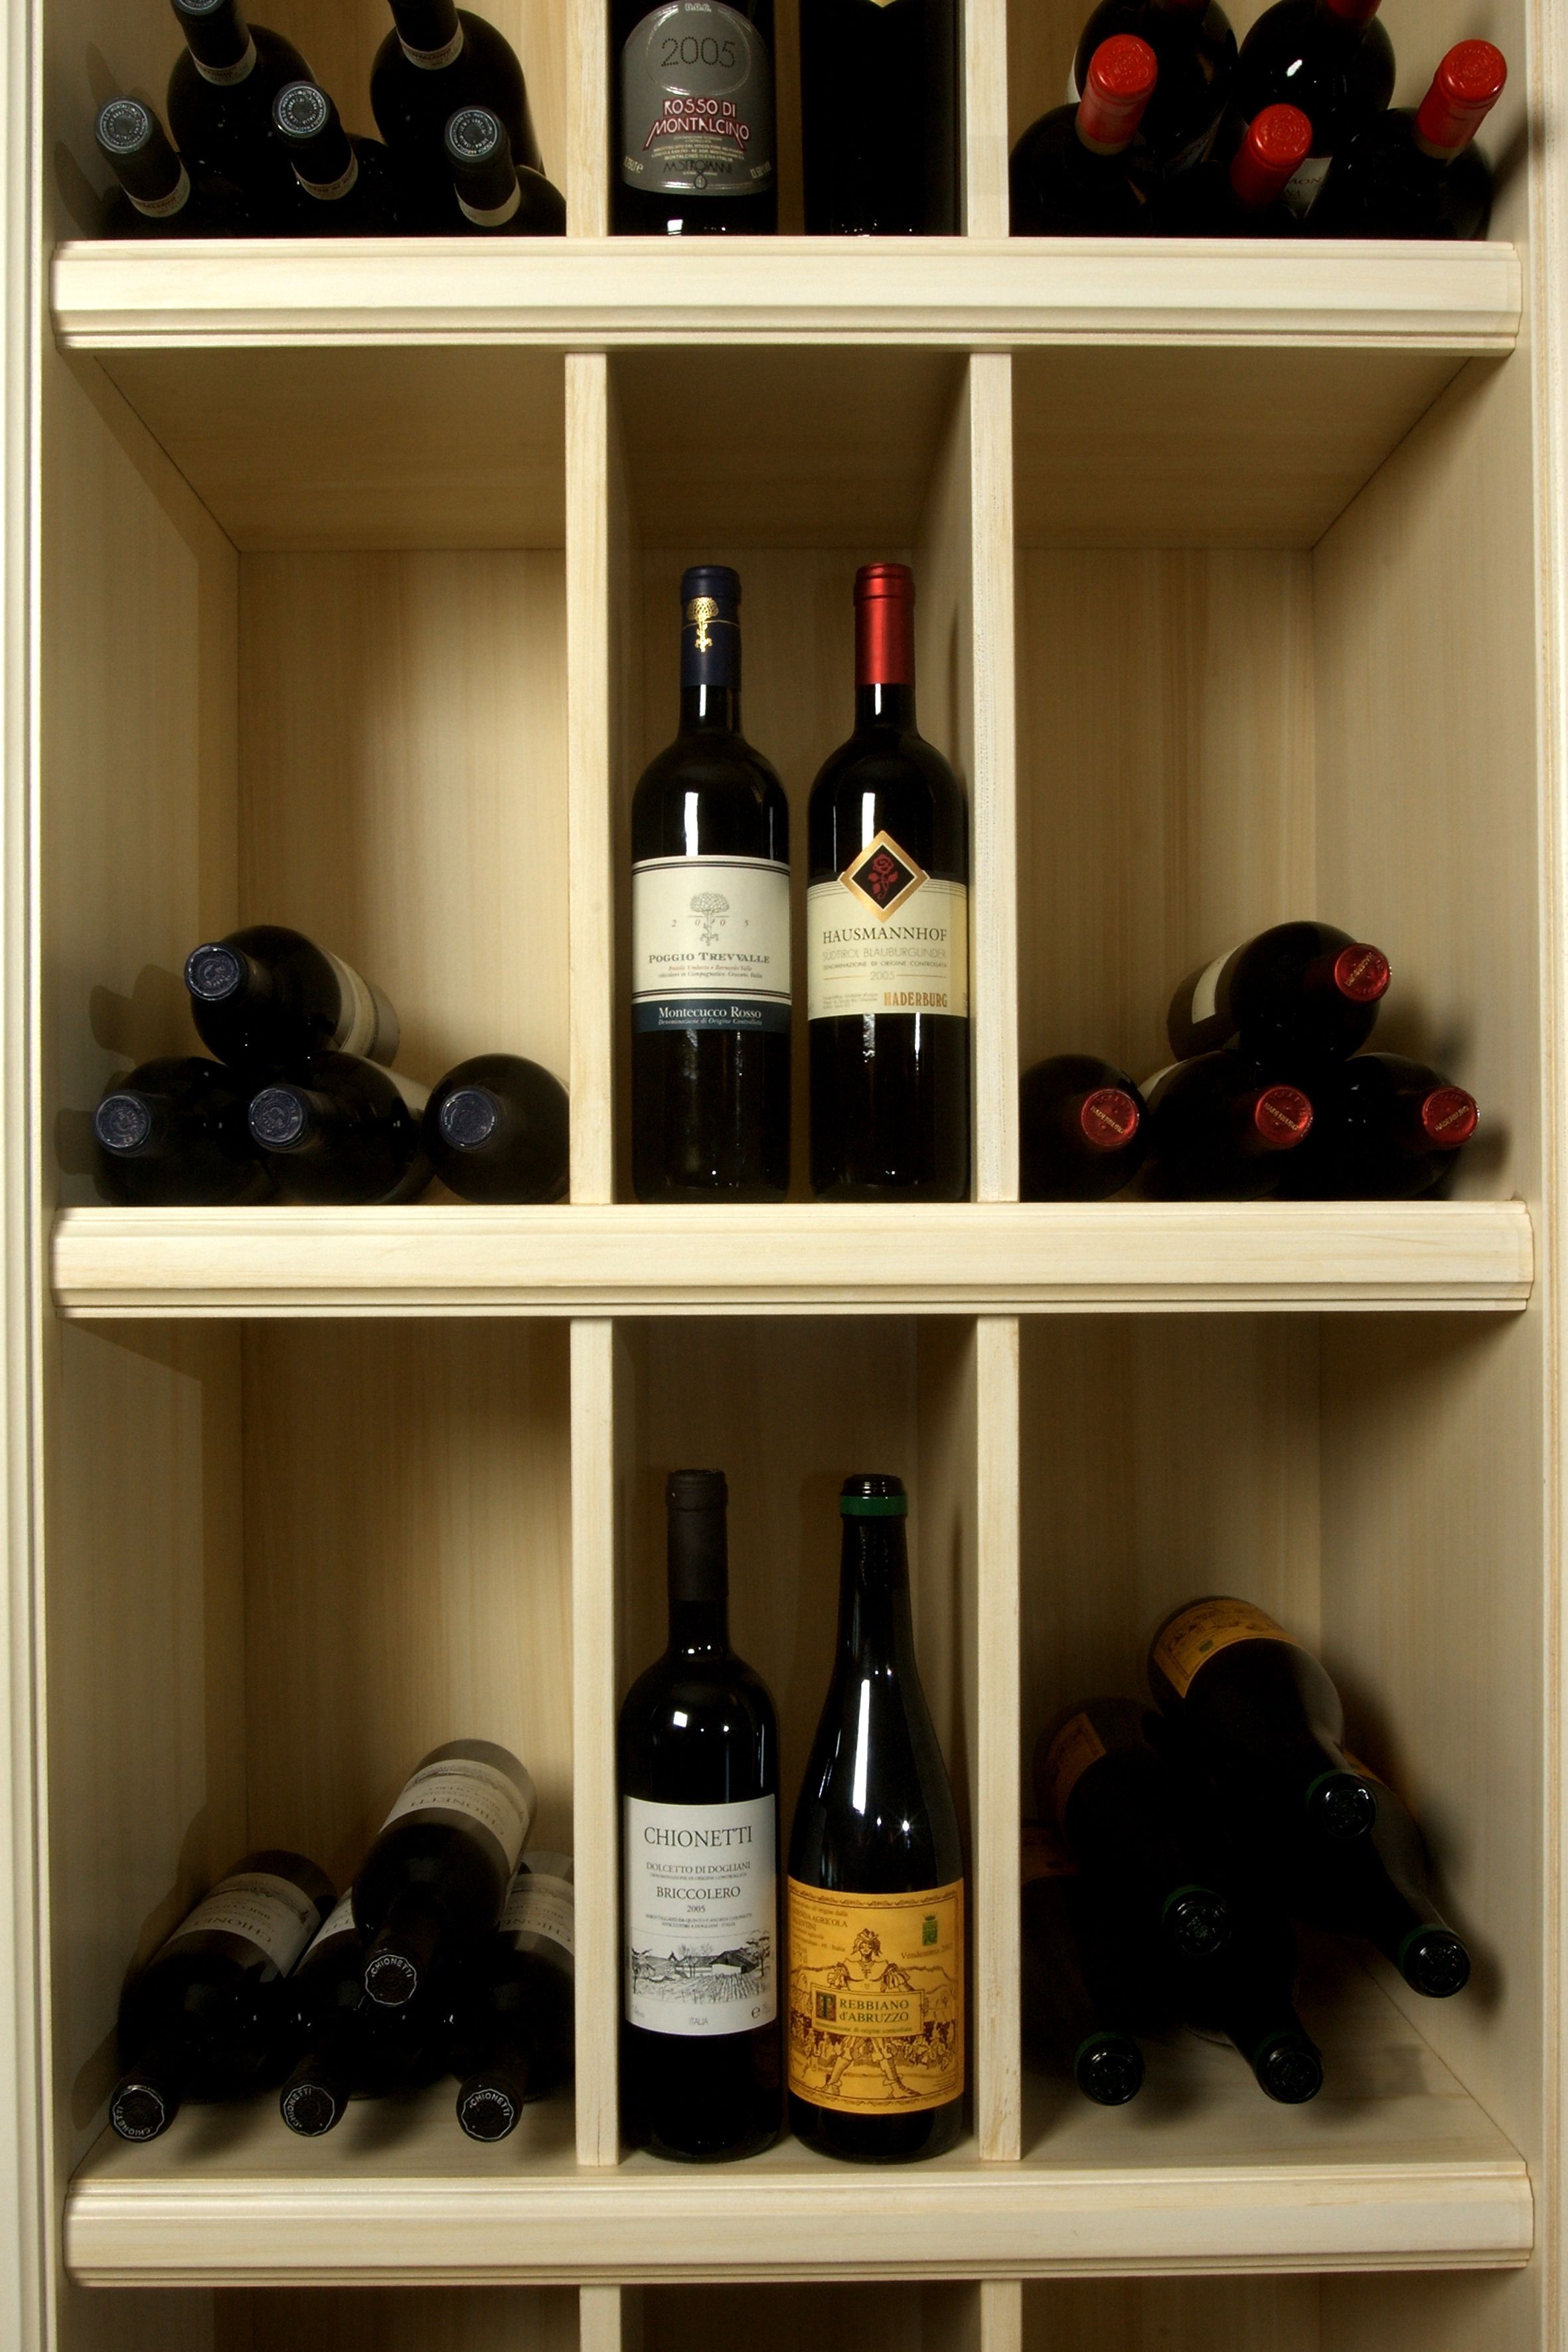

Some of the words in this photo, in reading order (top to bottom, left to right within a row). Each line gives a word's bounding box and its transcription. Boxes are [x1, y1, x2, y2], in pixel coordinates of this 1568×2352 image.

[661, 36, 736, 68] 2005
[664, 99, 718, 115] ROSSO
[723, 102, 736, 118] DI
[644, 117, 750, 149] MONTALCINO
[823, 927, 947, 944] HAUSMANNHOF
[649, 953, 695, 964] POGGIO
[864, 947, 947, 959] BLAUBURGUNDER
[870, 971, 896, 980] 2005
[884, 992, 948, 1008] HADERBURG
[659, 1006, 727, 1018] Montecucco
[731, 1006, 761, 1018] Rosso
[644, 1826, 753, 1847] CHIONETTI
[646, 1861, 693, 1874] DOLCETTO
[695, 1865, 706, 1874] DI
[708, 1861, 751, 1874] DOGLIANI
[657, 1886, 741, 1900] BRICCOLERO
[372, 1957, 414, 1978] CHIONETTI
[688, 2016, 709, 2025] ITALIA
[839, 2011, 909, 2023] d'ABRUZZO
[287, 2088, 312, 2128] CHIONETTI
[470, 2092, 510, 2117] CHIONETTI
[116, 2105, 151, 2136] CHIONETTI
